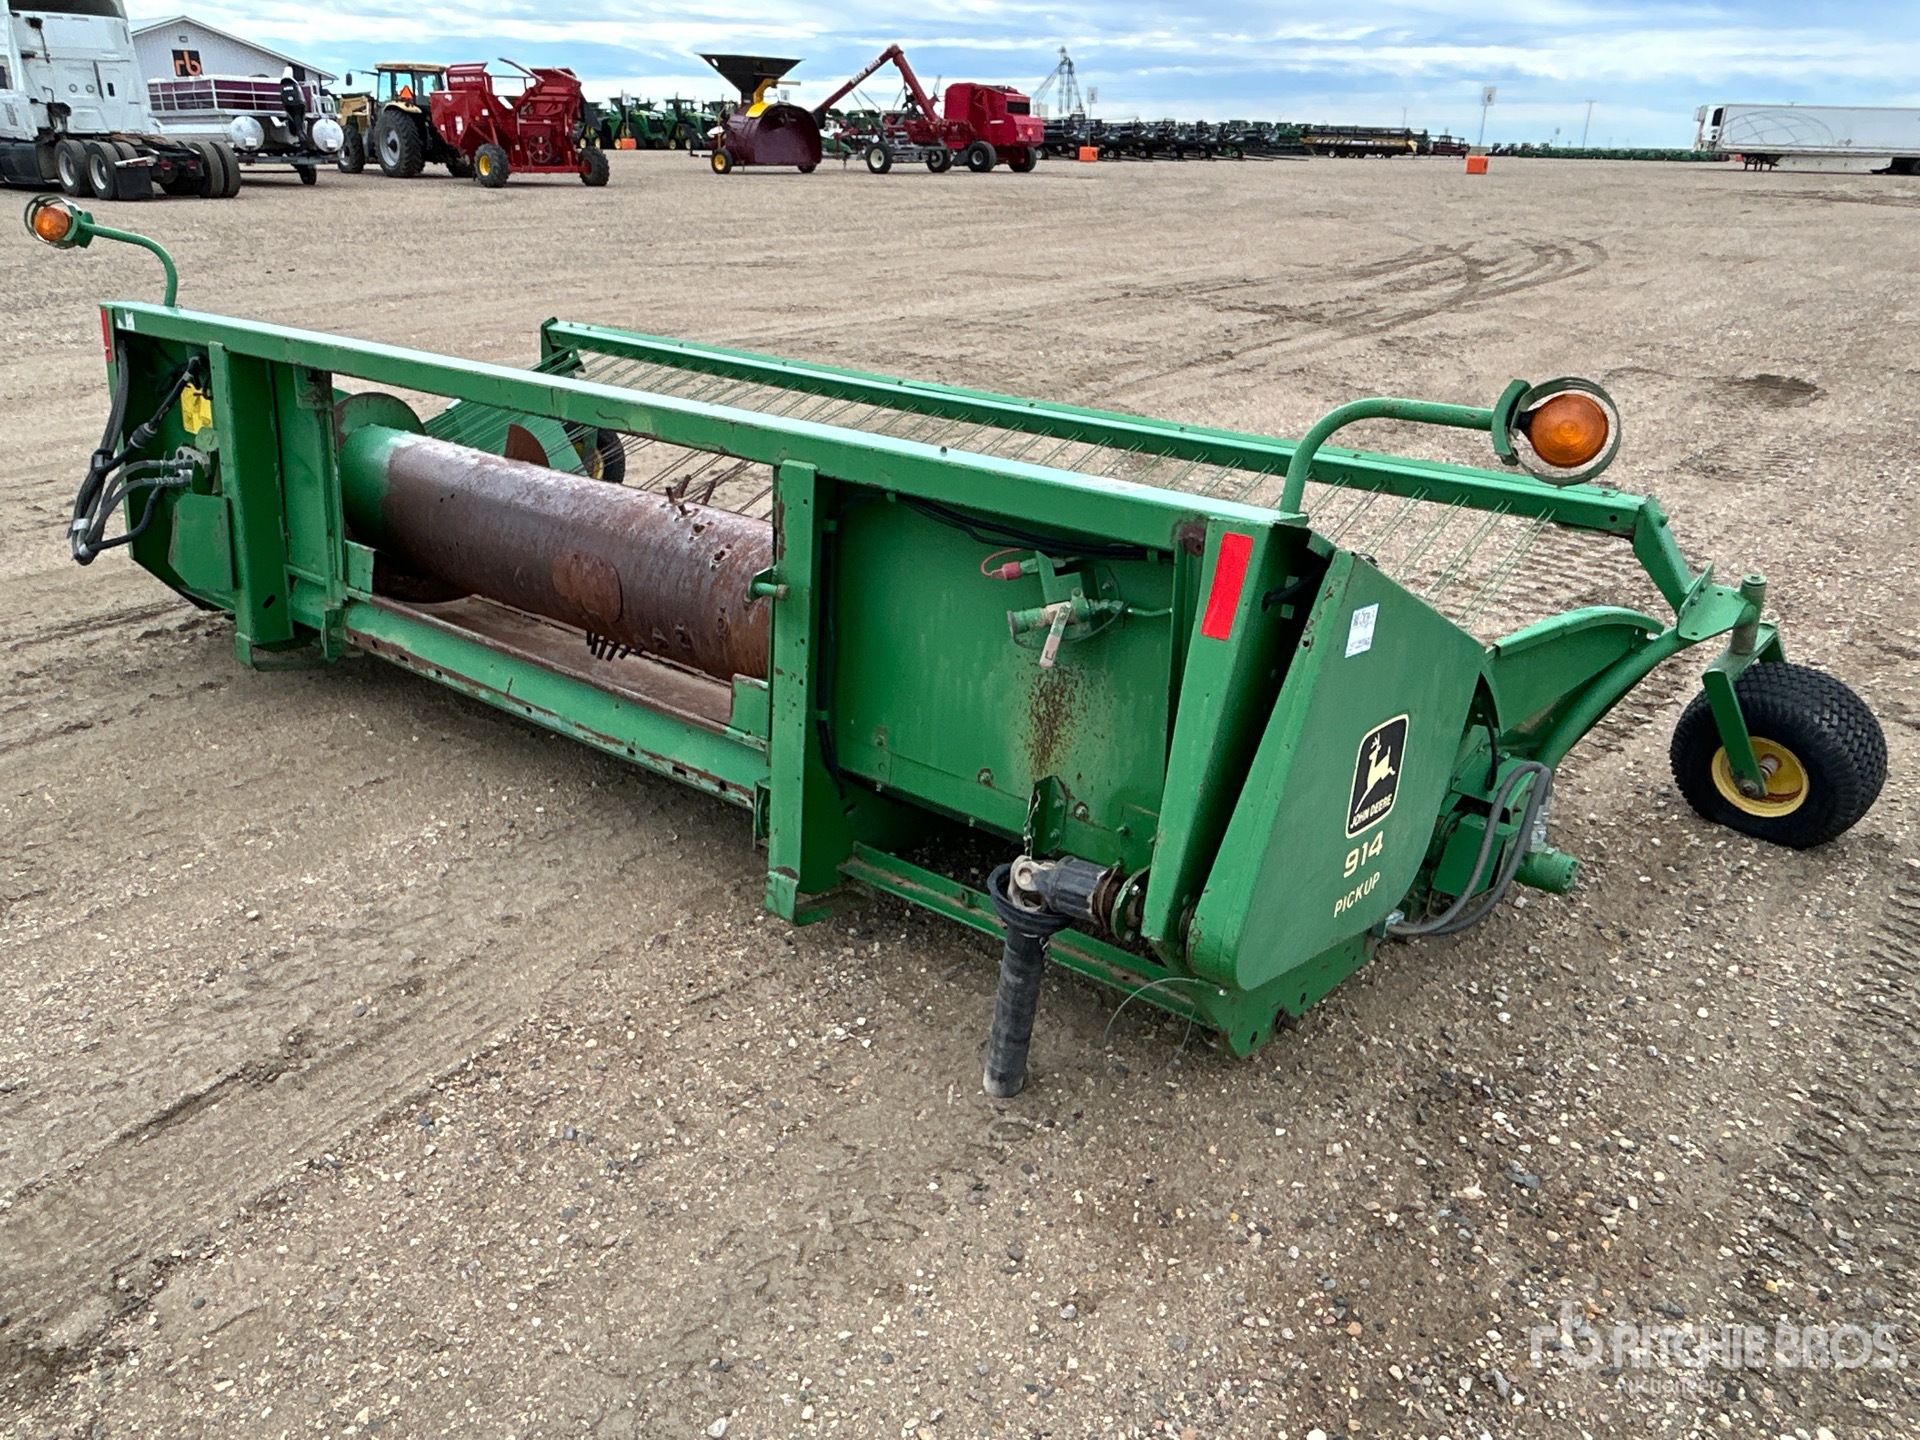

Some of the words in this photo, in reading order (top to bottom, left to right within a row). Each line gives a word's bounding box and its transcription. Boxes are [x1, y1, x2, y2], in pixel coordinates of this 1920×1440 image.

[175, 50, 201, 76] rb
[1487, 93, 1492, 103] 6
[1350, 810, 1369, 829] JOHN
[1370, 794, 1392, 816] DEERE
[1343, 830, 1384, 878] 914
[1333, 871, 1380, 918] PICKUP
